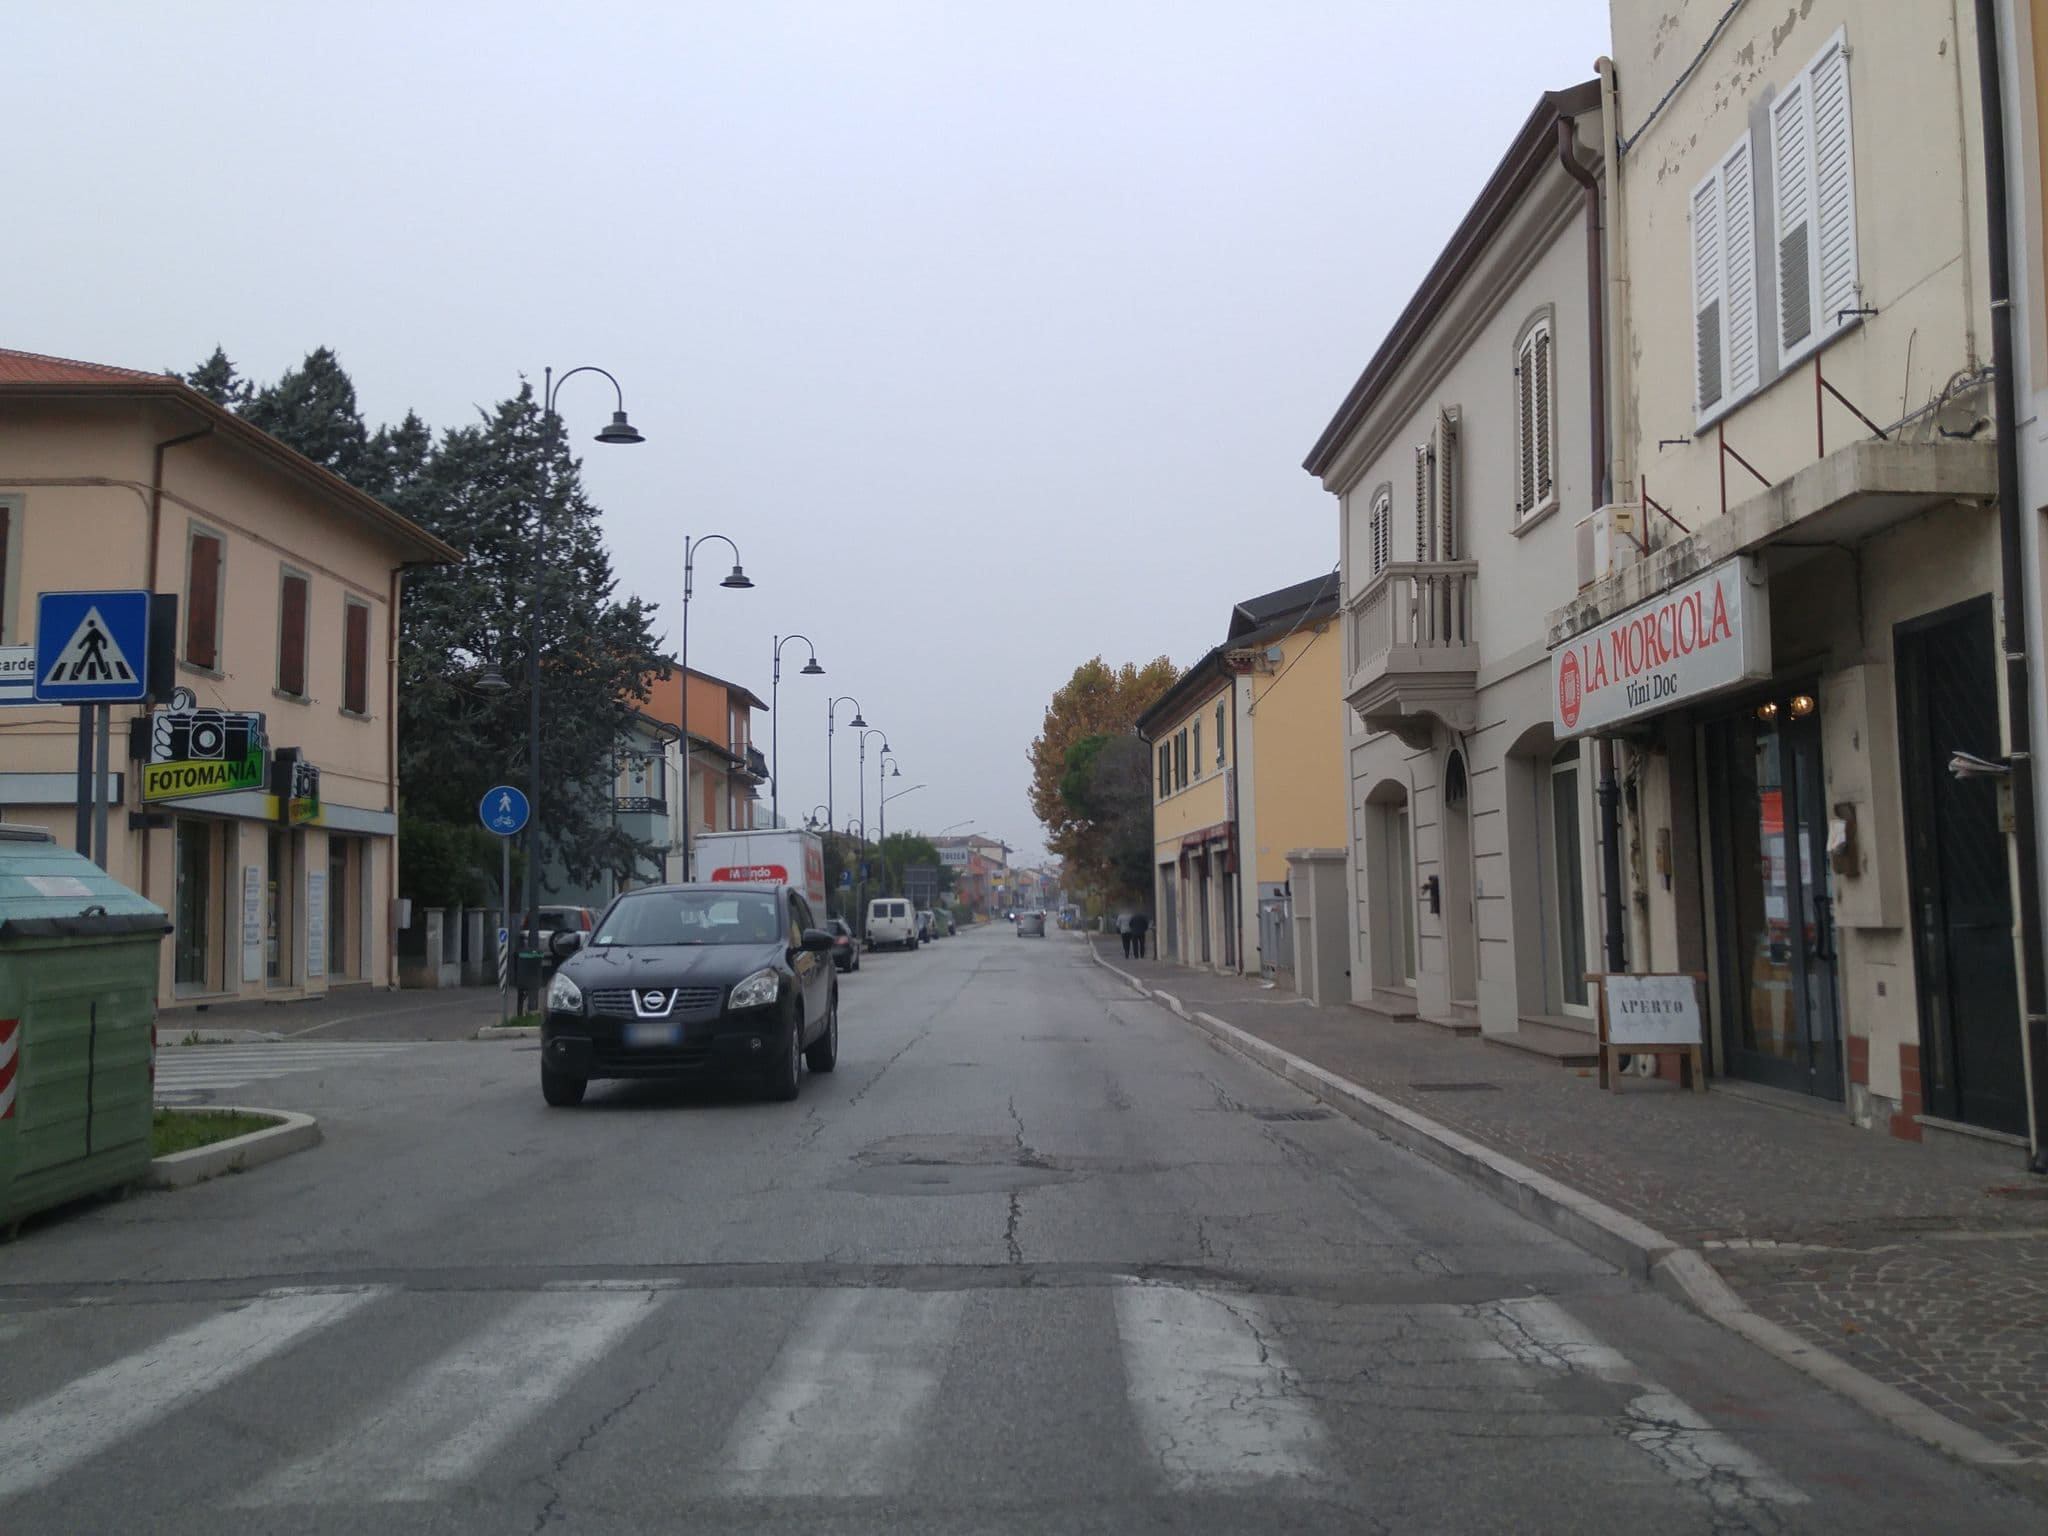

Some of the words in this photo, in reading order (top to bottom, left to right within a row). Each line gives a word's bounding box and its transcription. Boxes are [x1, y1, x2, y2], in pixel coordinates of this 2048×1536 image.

[1583, 638, 1608, 694] LA
[1611, 580, 1732, 682] MORCIOLA
[1626, 674, 1650, 709] Vini
[150, 762, 257, 792] FOTOMANIA
[1621, 999, 1683, 1014] APERTO
